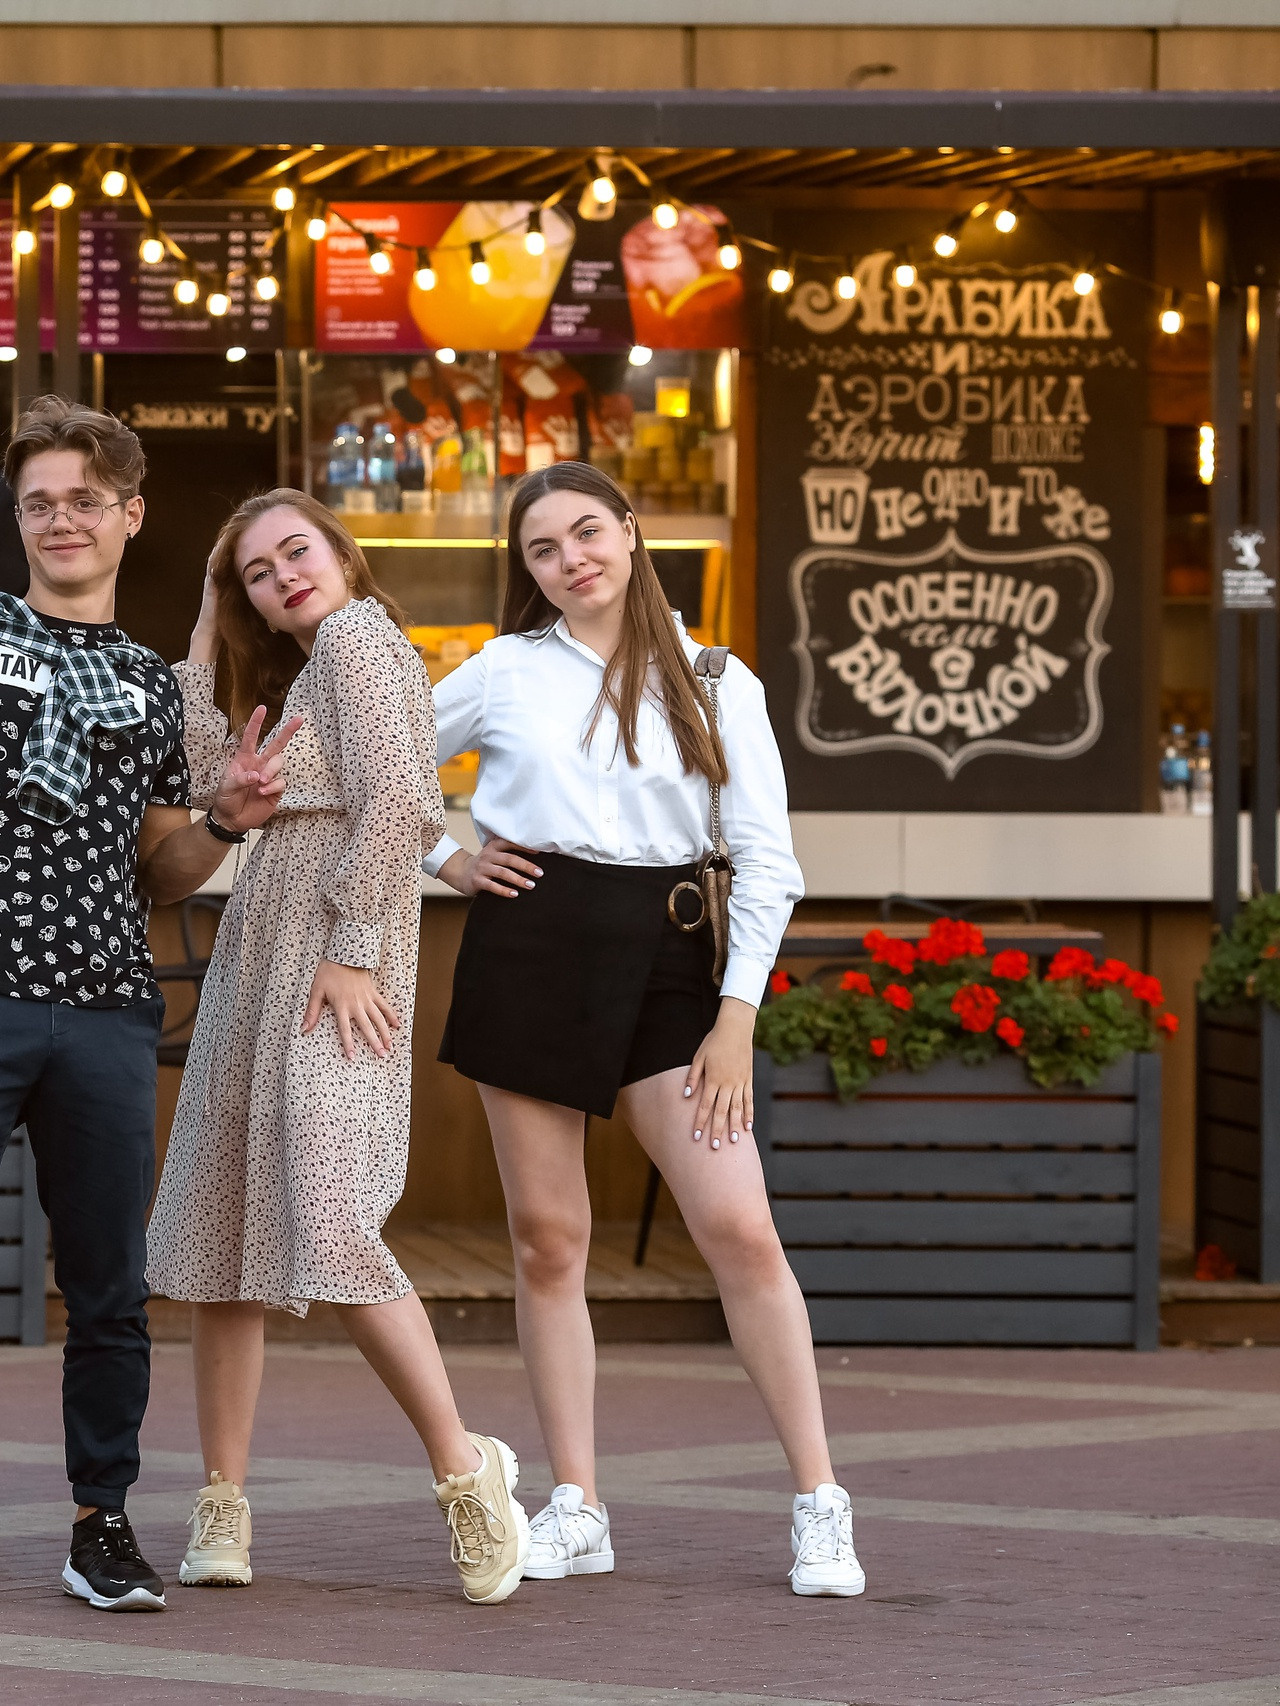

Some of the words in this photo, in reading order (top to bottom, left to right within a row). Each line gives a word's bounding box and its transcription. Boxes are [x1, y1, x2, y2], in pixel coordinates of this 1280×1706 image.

[807, 374, 1091, 423] АЭРОБИКА
[848, 570, 1060, 636] ОСОБЕННО
[826, 634, 1069, 738] БУЛОЧКОЙ
